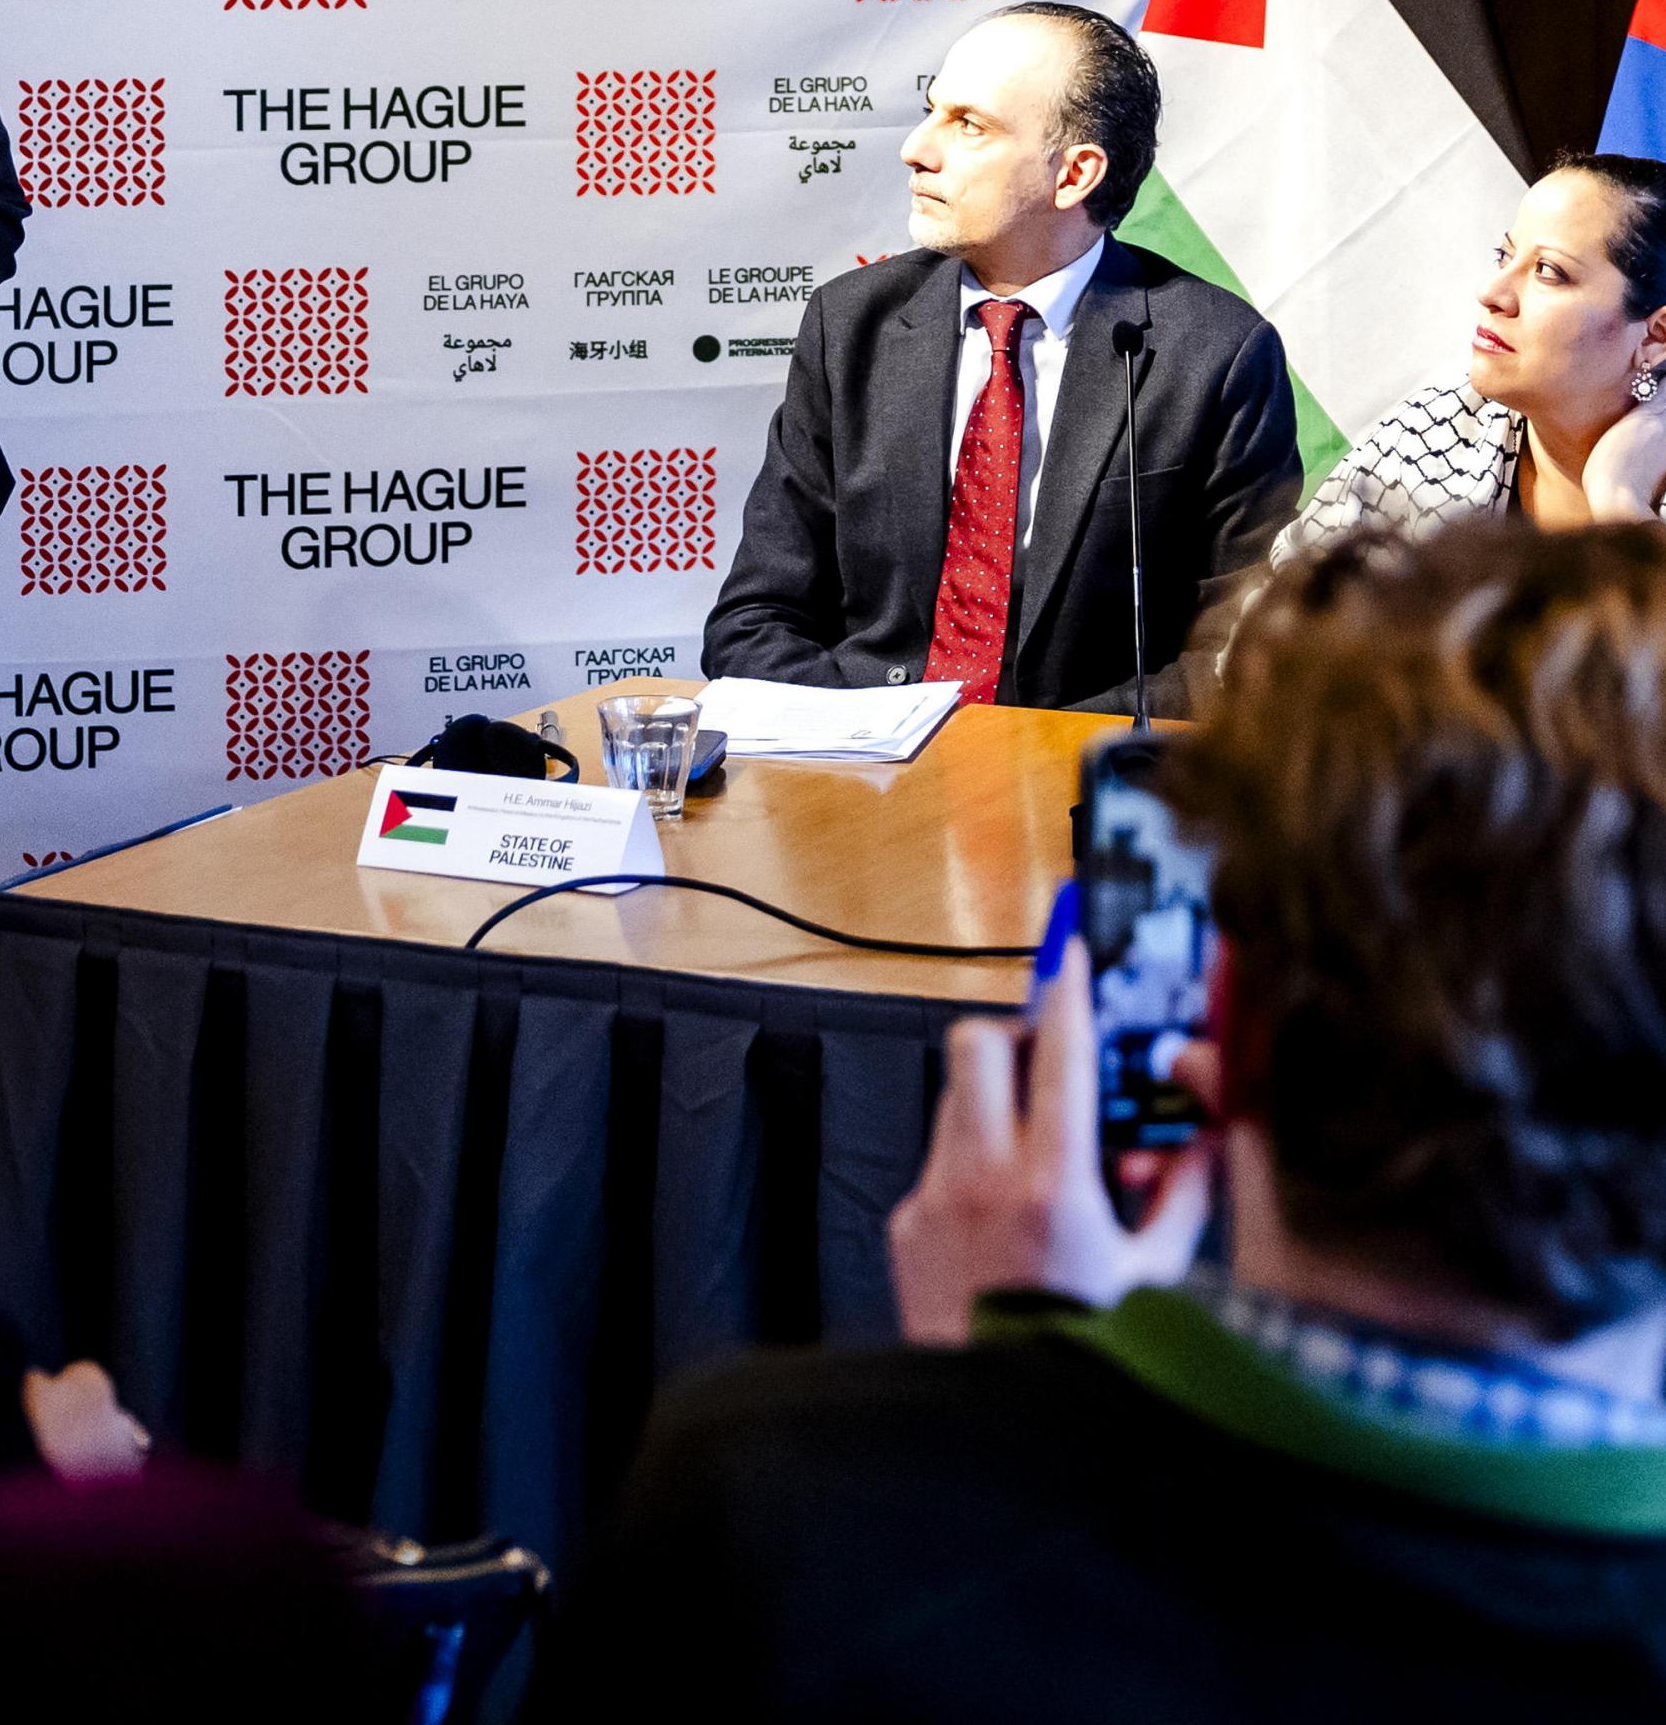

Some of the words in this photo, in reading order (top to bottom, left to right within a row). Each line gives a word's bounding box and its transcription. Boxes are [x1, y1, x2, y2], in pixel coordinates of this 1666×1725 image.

[774, 77, 798, 95] EL
[799, 76, 868, 94] GRUPO
[221, 86, 332, 133] THE
[342, 83, 527, 131] HAGUE
[768, 96, 795, 114] DE
[797, 96, 822, 113] LA
[824, 95, 874, 112] HAYA
[788, 136, 856, 156] مجموعة
[279, 138, 473, 187] GROUP
[798, 154, 842, 184] لاهاي
[222, 470, 333, 519] THE
[343, 465, 528, 515] HAGUE
[279, 519, 474, 571] GROUP
[429, 656, 454, 674] EL
[455, 652, 526, 672] GRUPO
[574, 646, 675, 667] ГААГСКАЯ
[424, 675, 452, 694] DE
[454, 674, 479, 692] LA
[480, 672, 532, 691] HAYA
[500, 833, 549, 852] STATE
[549, 838, 573, 854] OF
[488, 849, 575, 872] PALESTINE
